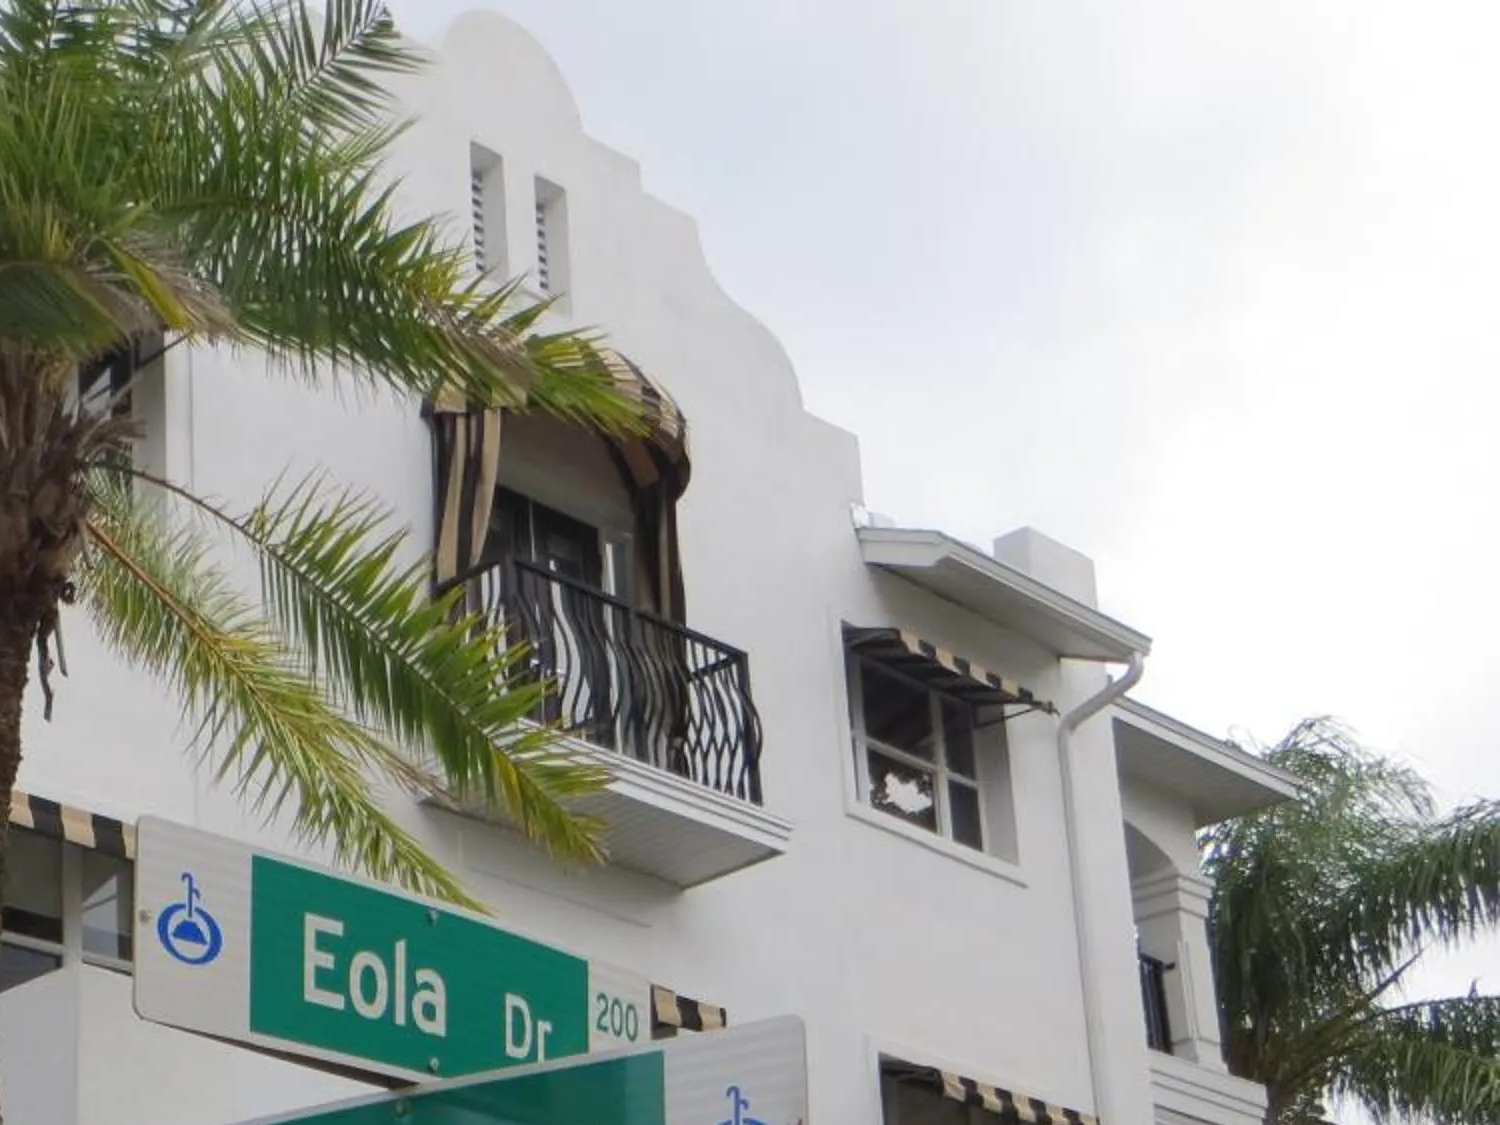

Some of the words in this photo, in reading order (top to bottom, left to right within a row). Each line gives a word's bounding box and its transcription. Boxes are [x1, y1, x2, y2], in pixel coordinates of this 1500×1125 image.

[303, 912, 447, 1037] Eola
[504, 992, 552, 1064] Dr
[596, 993, 638, 1042] 200
